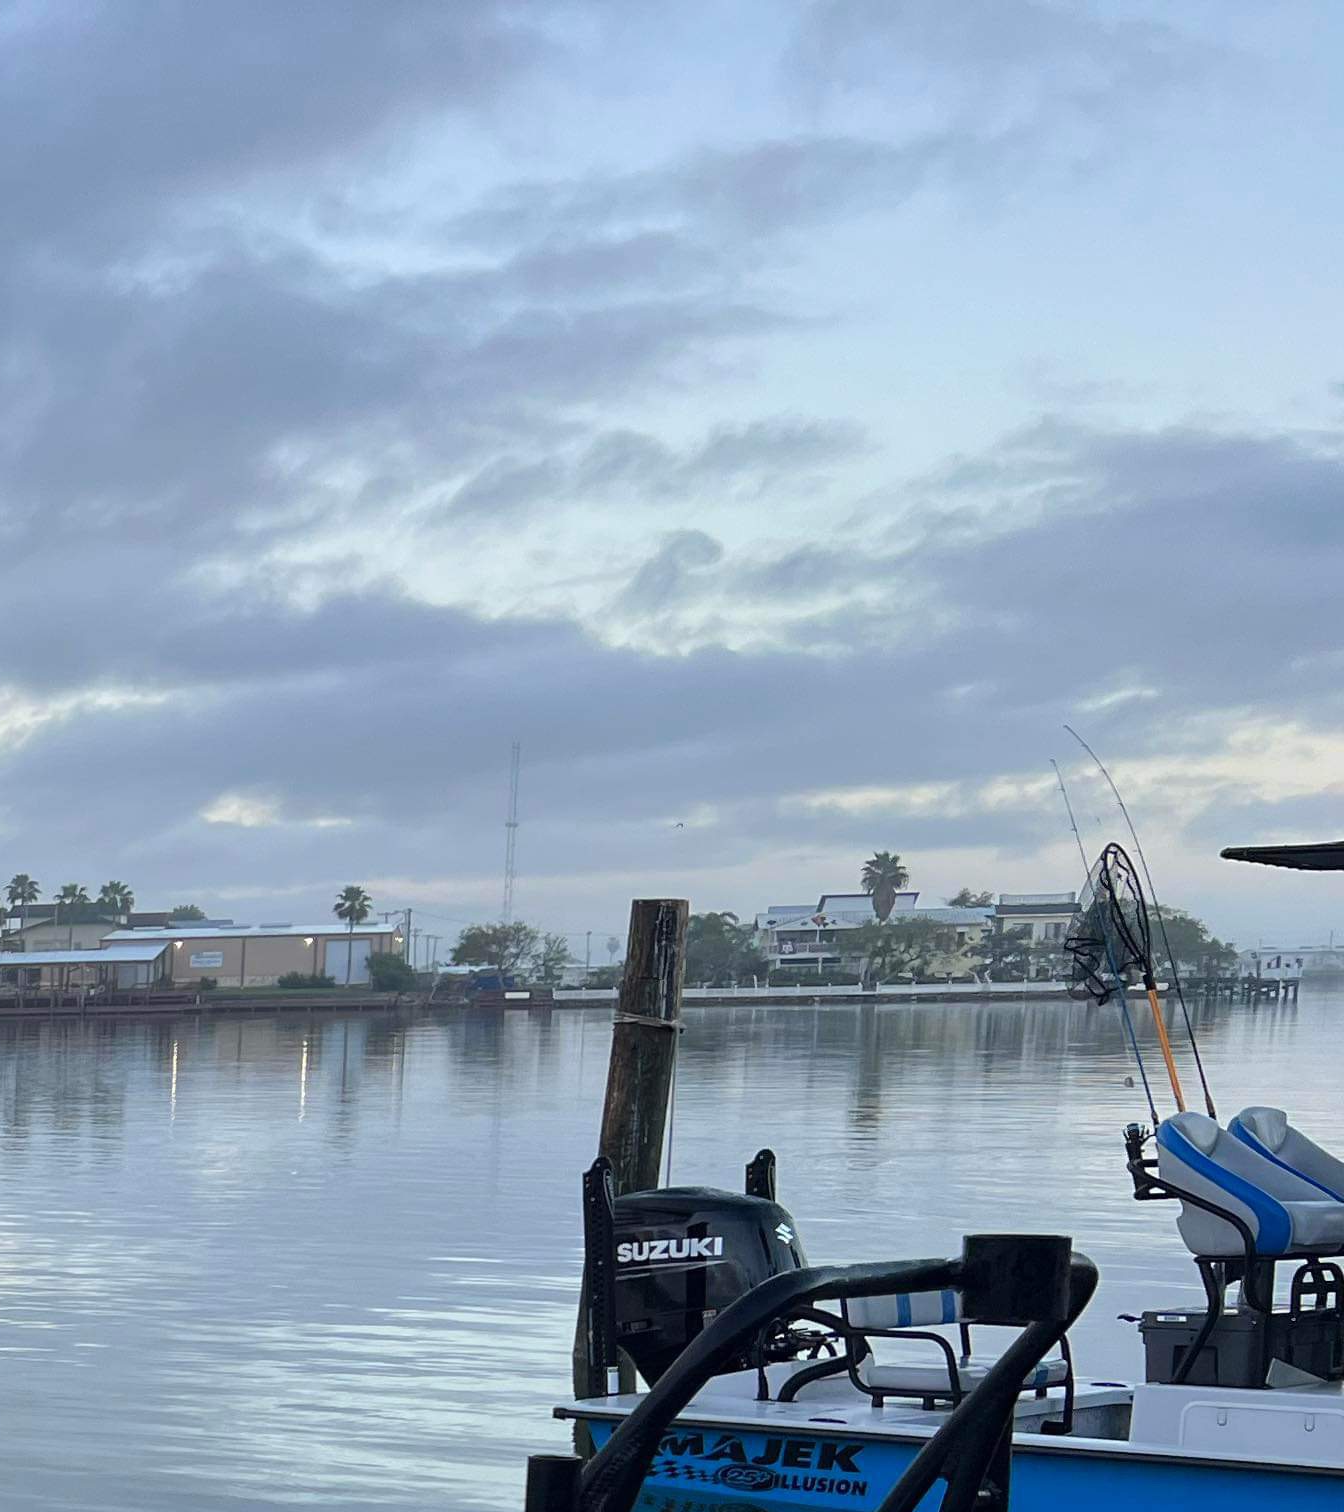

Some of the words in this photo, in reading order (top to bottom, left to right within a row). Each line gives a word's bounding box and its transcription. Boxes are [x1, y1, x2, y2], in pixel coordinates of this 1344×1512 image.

[617, 1237, 723, 1262] SUZUKI
[655, 1432, 865, 1473] MAJEK
[774, 1473, 868, 1497] ILLUSION
